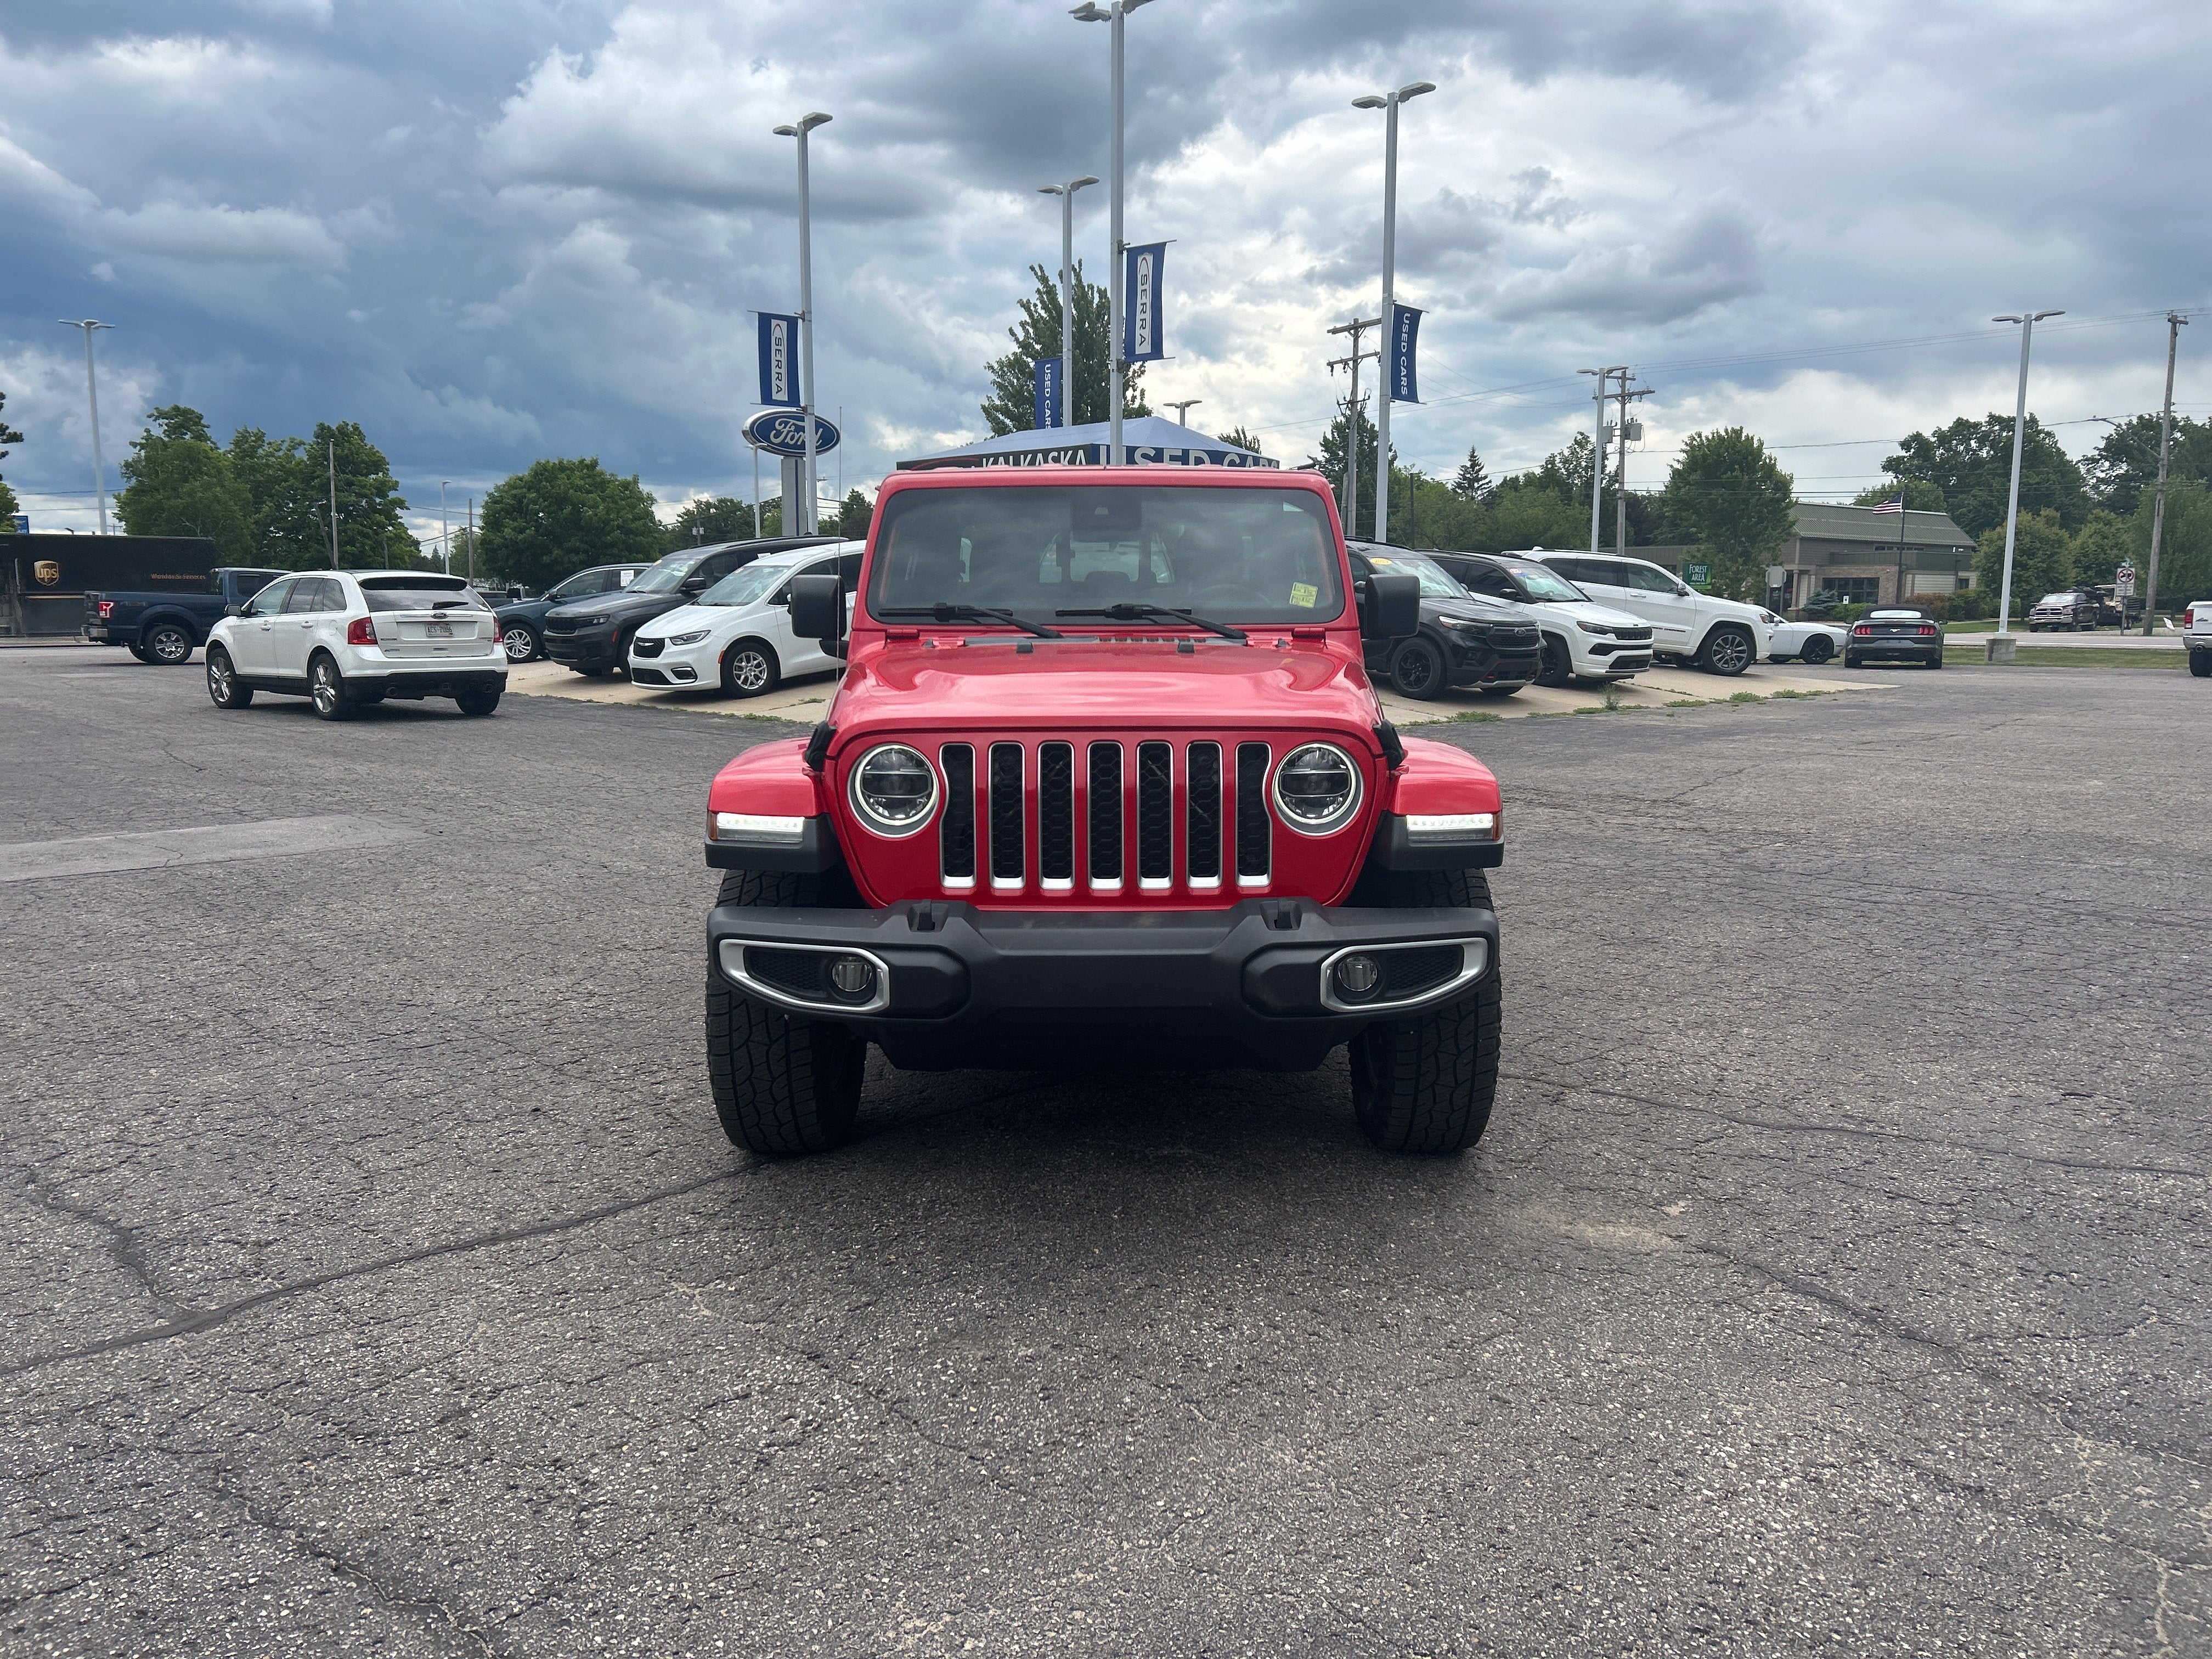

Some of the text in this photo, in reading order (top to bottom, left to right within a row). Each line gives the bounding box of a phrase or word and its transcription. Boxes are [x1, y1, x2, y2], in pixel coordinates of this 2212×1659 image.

[1138, 274, 1148, 347] SERRA
[1401, 313, 1411, 353] USED
[770, 418, 823, 447] For
[1099, 445, 1211, 466] SED
[36, 568, 58, 582] ups
[1689, 564, 1707, 574] FOREST
[1691, 573, 1705, 582] AREA
